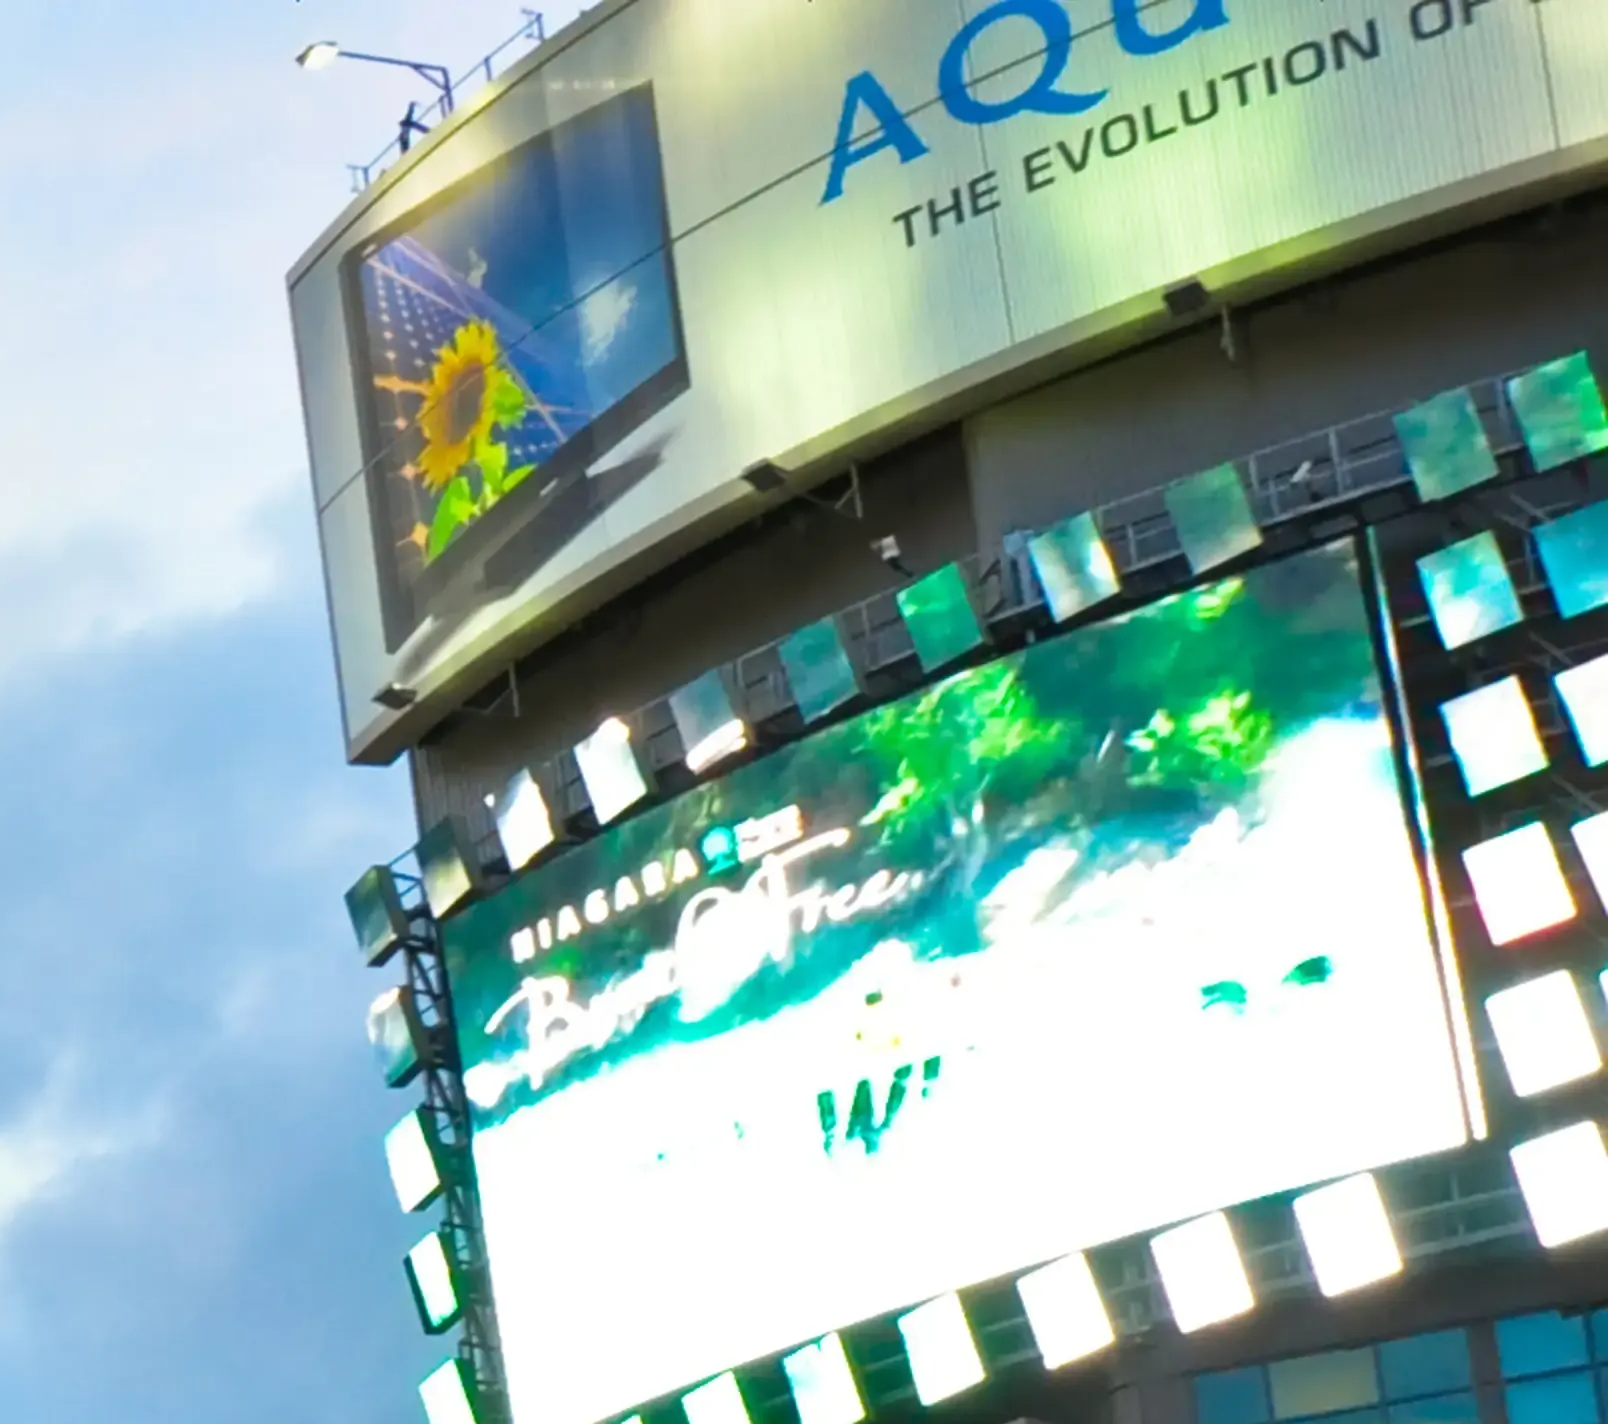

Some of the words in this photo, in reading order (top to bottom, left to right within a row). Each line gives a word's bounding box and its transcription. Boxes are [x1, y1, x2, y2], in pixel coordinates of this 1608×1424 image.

[892, 170, 1003, 248] THE
[1024, 18, 1380, 194] EVOLUTION
[1409, 0, 1483, 41] OF
[510, 847, 700, 963] NIAGARA
